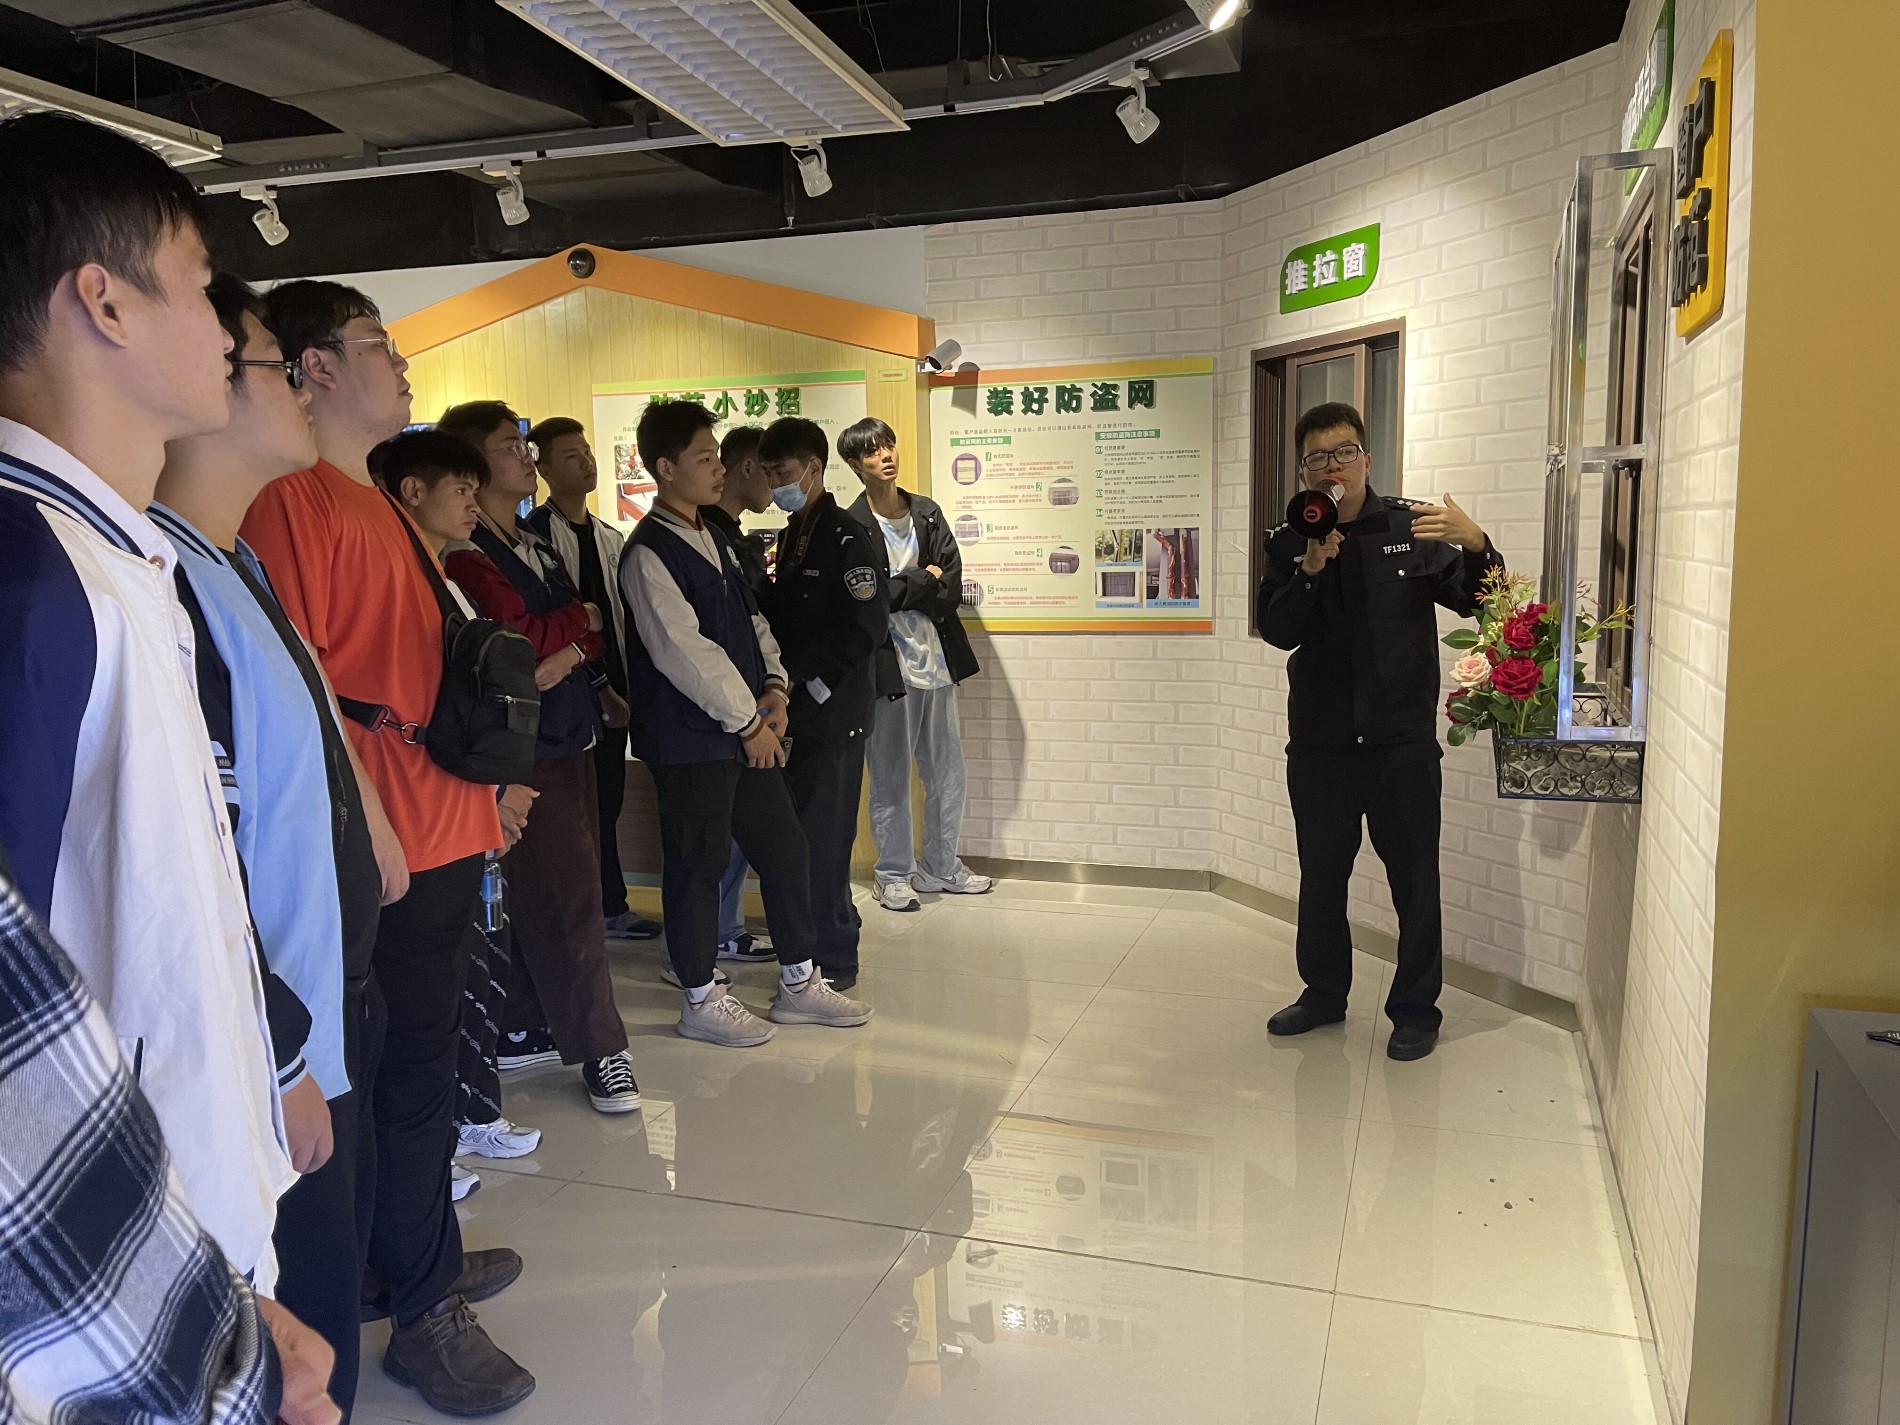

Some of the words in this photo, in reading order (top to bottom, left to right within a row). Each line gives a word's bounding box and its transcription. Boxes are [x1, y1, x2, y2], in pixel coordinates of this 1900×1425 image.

[1286, 243, 1366, 296] 推拉窗
[986, 380, 1156, 417] 装好防盗网
[1383, 543, 1411, 554] TF1321
